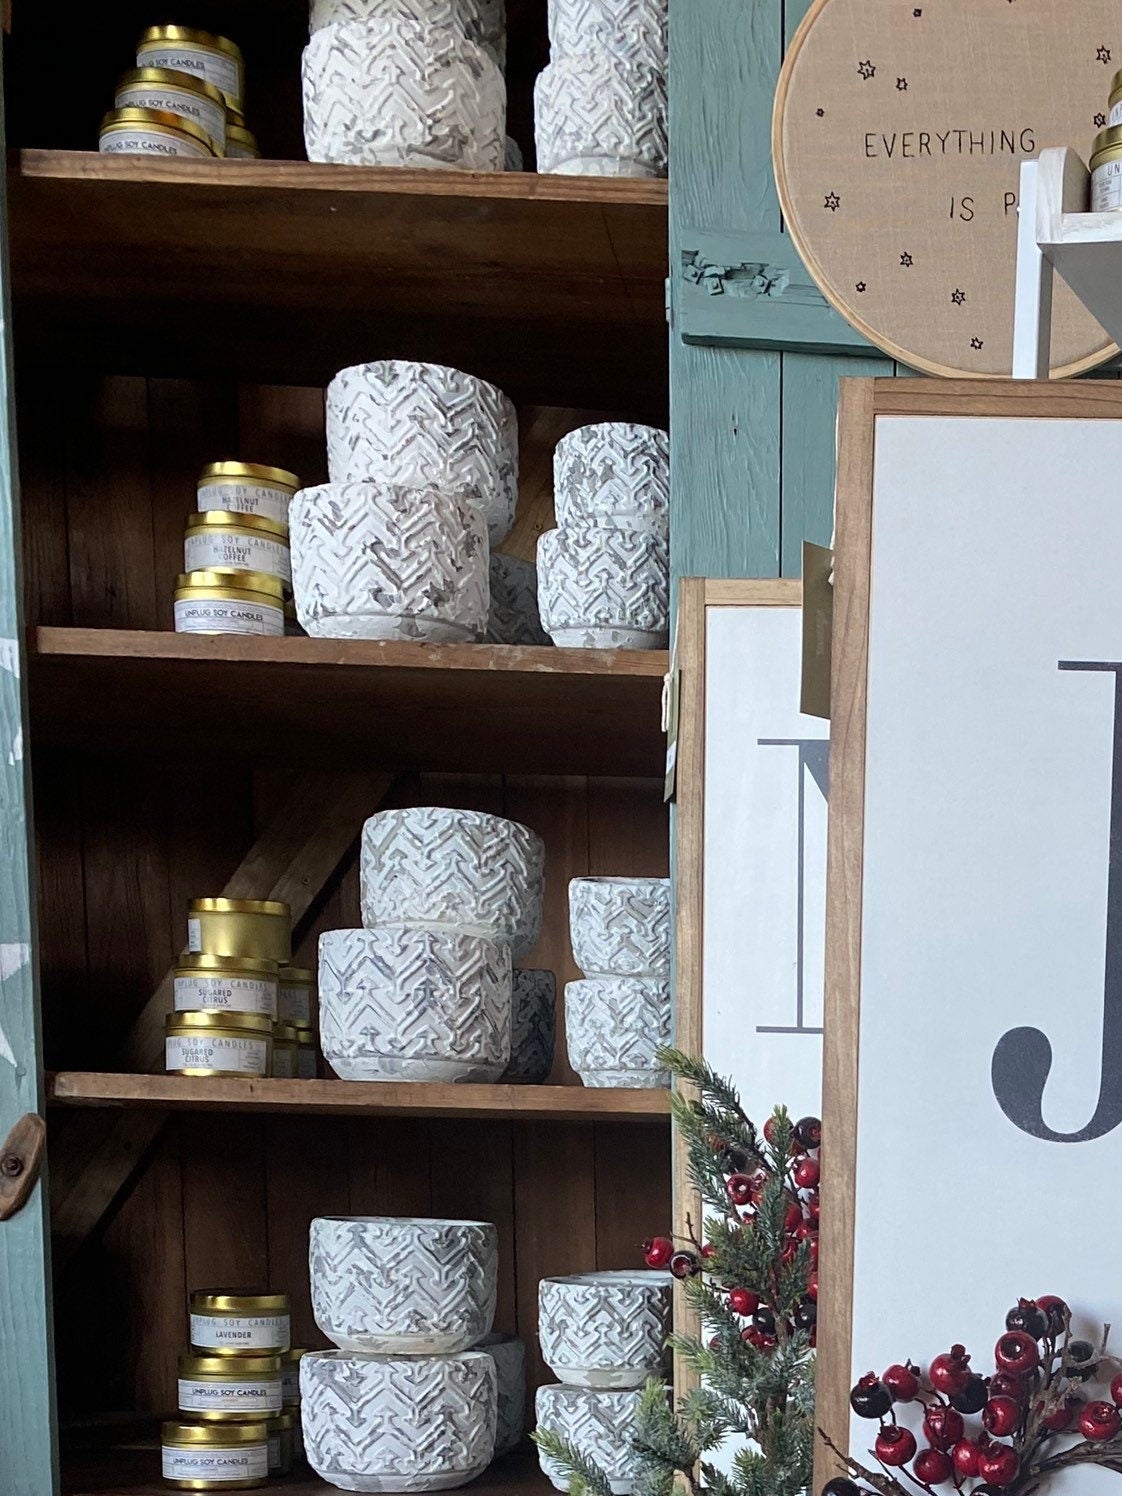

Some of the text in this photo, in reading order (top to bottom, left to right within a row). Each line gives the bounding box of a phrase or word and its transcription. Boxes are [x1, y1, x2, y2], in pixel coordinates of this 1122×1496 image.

[865, 127, 1036, 158] EVERYTHING
[949, 191, 1020, 222] IS P
[184, 608, 264, 622] UNPLUG SOY CANDLES
[230, 980, 268, 991] CANDLES
[212, 1040, 253, 1050] CANDLES
[224, 1319, 240, 1327] SOY
[215, 1331, 251, 1339] LAVENDER
[192, 1388, 267, 1396] UNPLUG SOY CANDLES
[173, 1457, 249, 1466] UNPLUG SOY CANDLES
